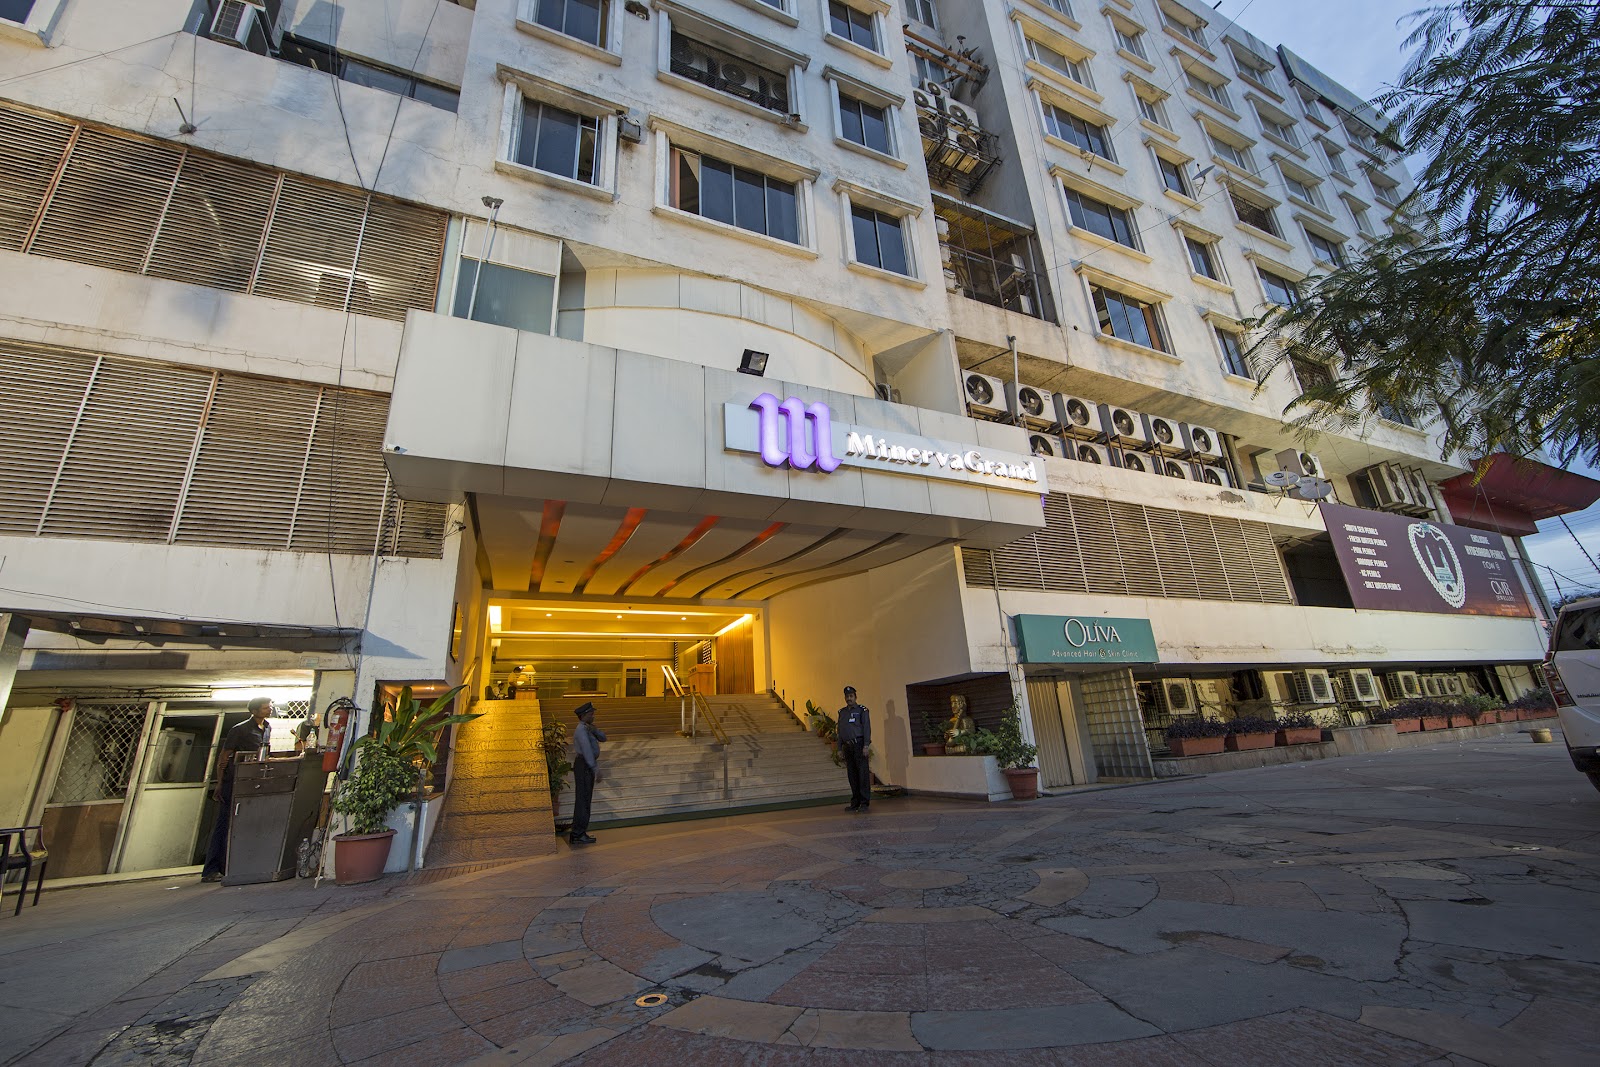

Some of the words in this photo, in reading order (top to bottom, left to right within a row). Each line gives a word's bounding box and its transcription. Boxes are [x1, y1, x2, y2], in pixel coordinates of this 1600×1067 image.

[1491, 581, 1513, 595] CMR
[1052, 650, 1082, 658] Advanced
[1108, 650, 1121, 658] Skin
[1122, 650, 1139, 658] Clinic
